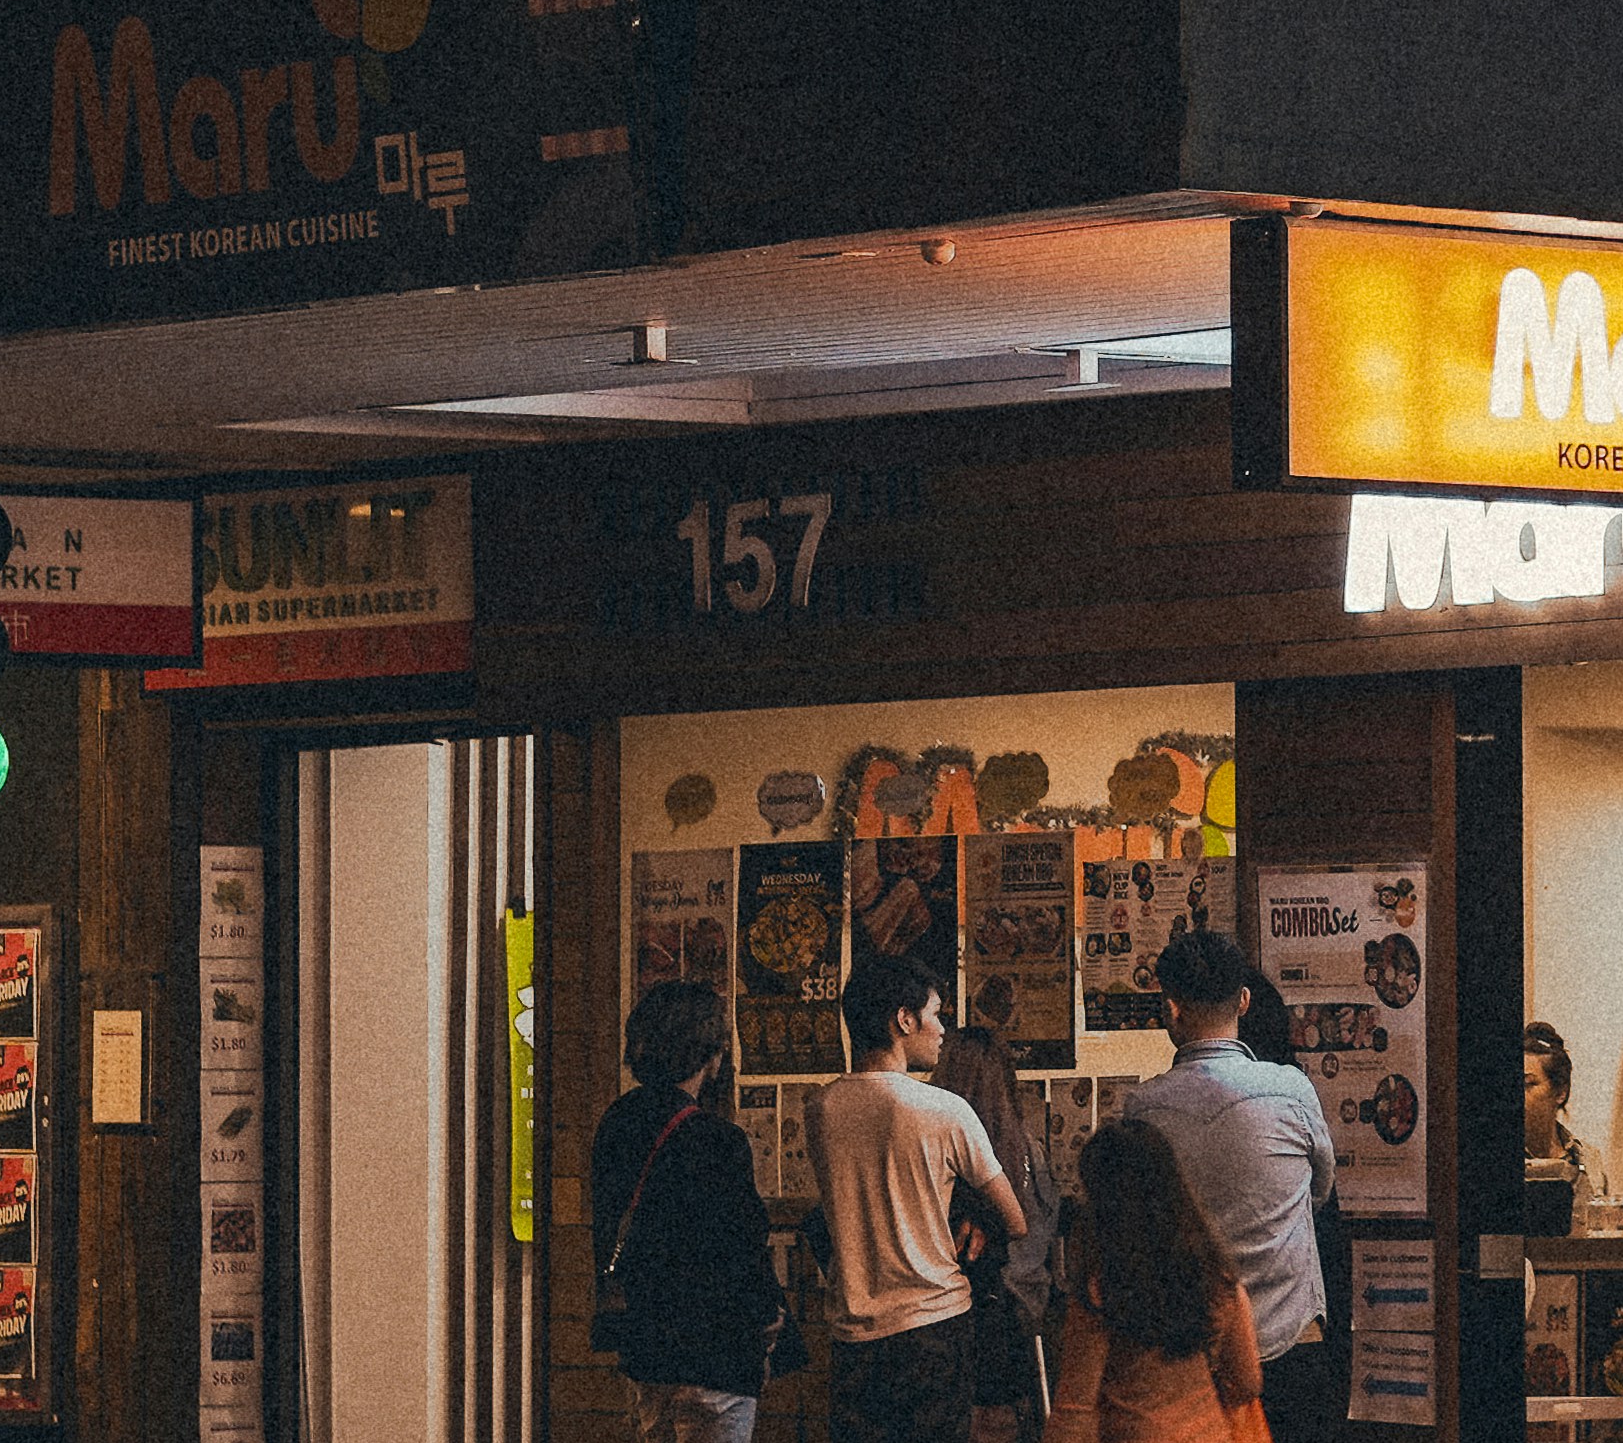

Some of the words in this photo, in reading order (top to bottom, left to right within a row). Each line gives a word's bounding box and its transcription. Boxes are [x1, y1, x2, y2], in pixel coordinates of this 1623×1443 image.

[47, 14, 362, 217] Maru
[373, 129, 471, 237] 마루
[107, 230, 185, 269] FINEST
[189, 220, 284, 260] KOREAN
[286, 208, 381, 253] CUISINE
[677, 492, 833, 612] 157
[257, 586, 439, 625] SUPERMARKET
[210, 924, 246, 939] $1.80
[1270, 907, 1331, 939] COMBO
[1329, 907, 1360, 936] Set
[800, 976, 838, 1004] $38
[211, 1036, 247, 1052] $1.80
